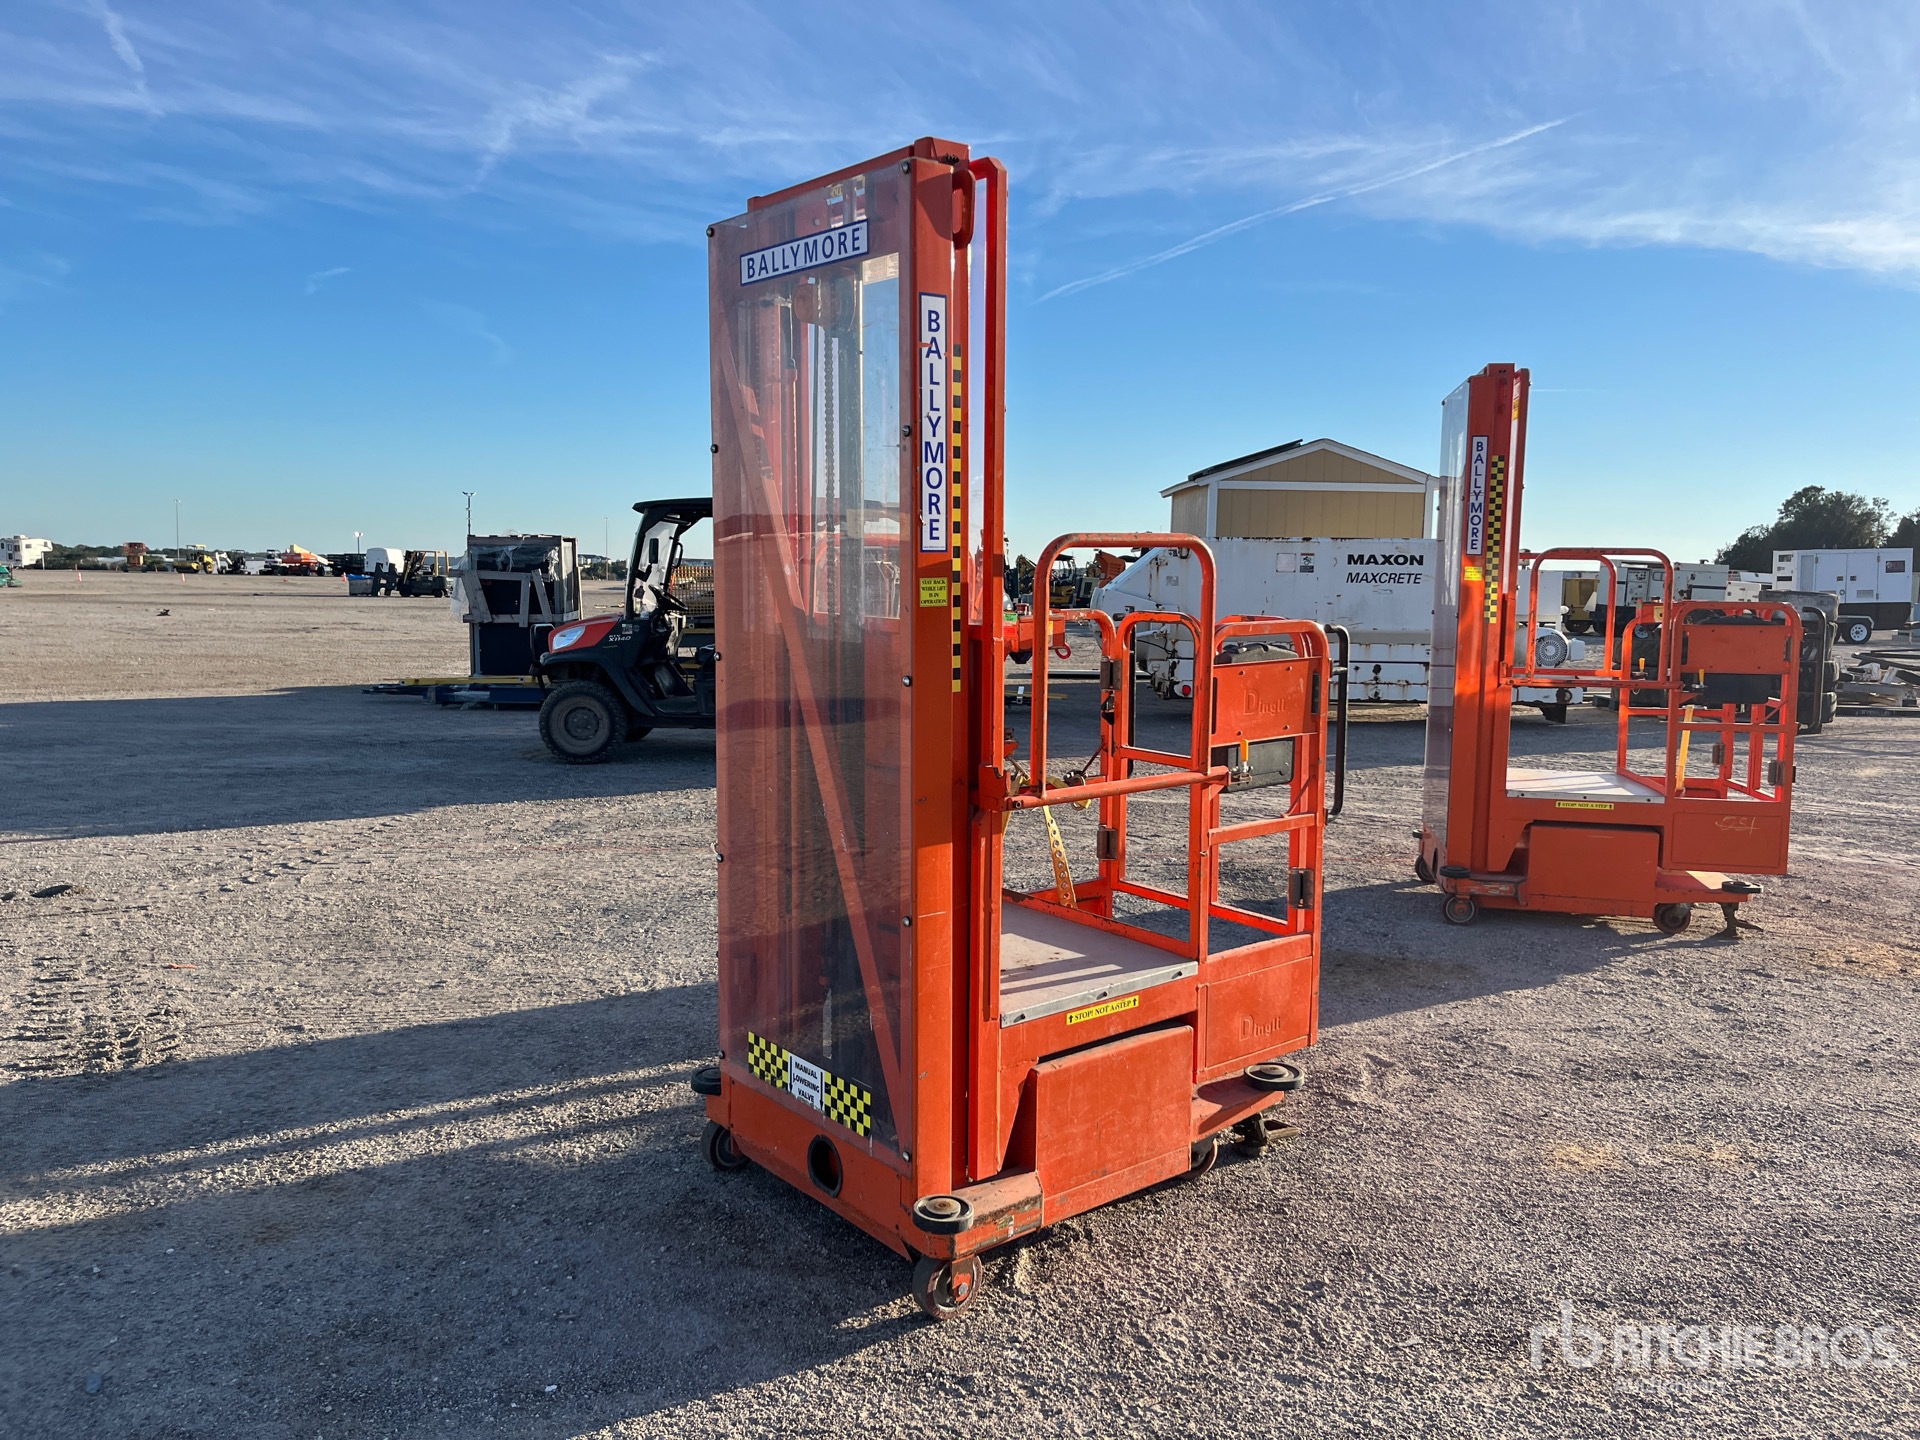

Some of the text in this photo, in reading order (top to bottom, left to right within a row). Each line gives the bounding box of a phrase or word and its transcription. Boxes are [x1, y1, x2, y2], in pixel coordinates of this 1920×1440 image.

[745, 226, 862, 280] BALLYMORE
[924, 309, 944, 541] BALLYMORE
[1470, 441, 1484, 550] BALLYMORE
[1347, 554, 1424, 566] MAXON
[1345, 572, 1422, 585] MAXCRETE
[1074, 1010, 1094, 1021] STOP!
[1095, 1005, 1110, 1016] NOT
[1115, 999, 1132, 1010] STEP
[1239, 1015, 1281, 1042] Dingli
[794, 1061, 818, 1080] MANUAL
[792, 1072, 820, 1093] LOWERING
[797, 1087, 815, 1103] VALVE
